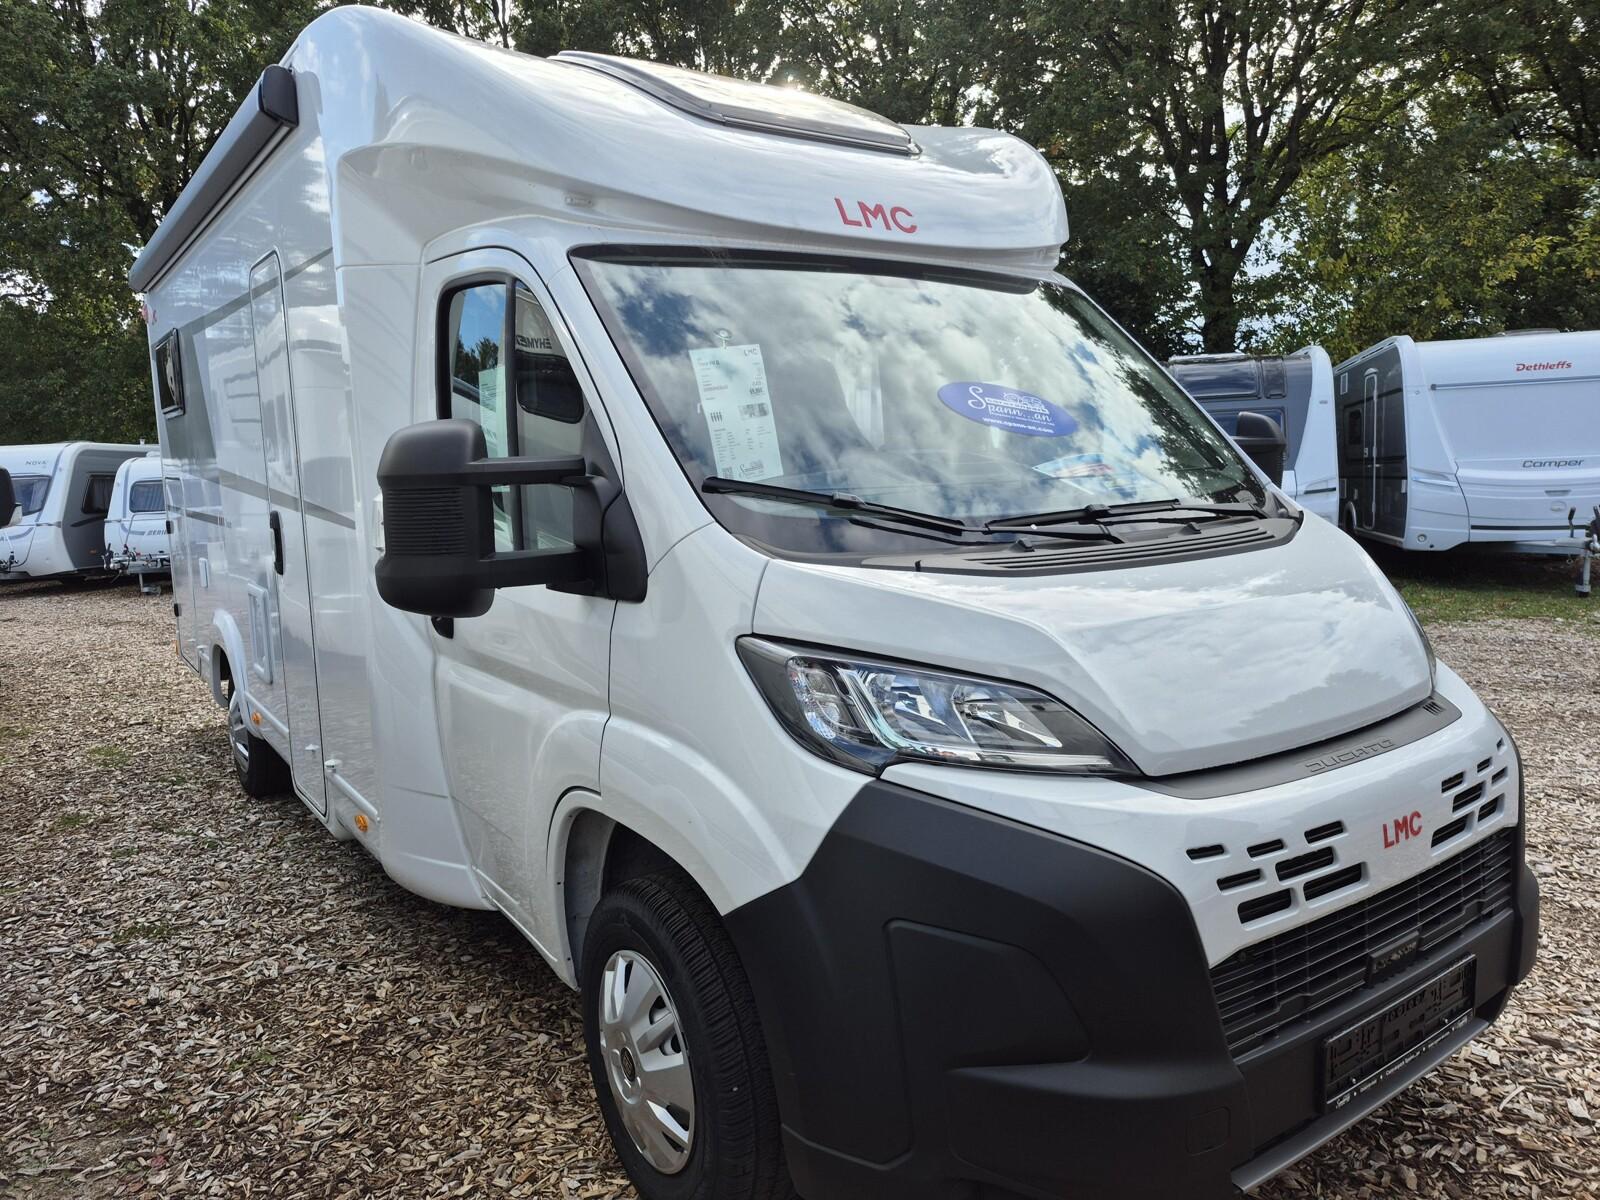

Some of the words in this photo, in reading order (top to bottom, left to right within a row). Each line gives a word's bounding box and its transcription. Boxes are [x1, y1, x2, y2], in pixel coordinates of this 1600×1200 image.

[834, 197, 918, 234] LMC
[1516, 361, 1573, 372] Dethleffs
[1522, 459, 1585, 469] Camper
[1305, 739, 1397, 774] DUCATO
[1382, 810, 1423, 849] LMC
